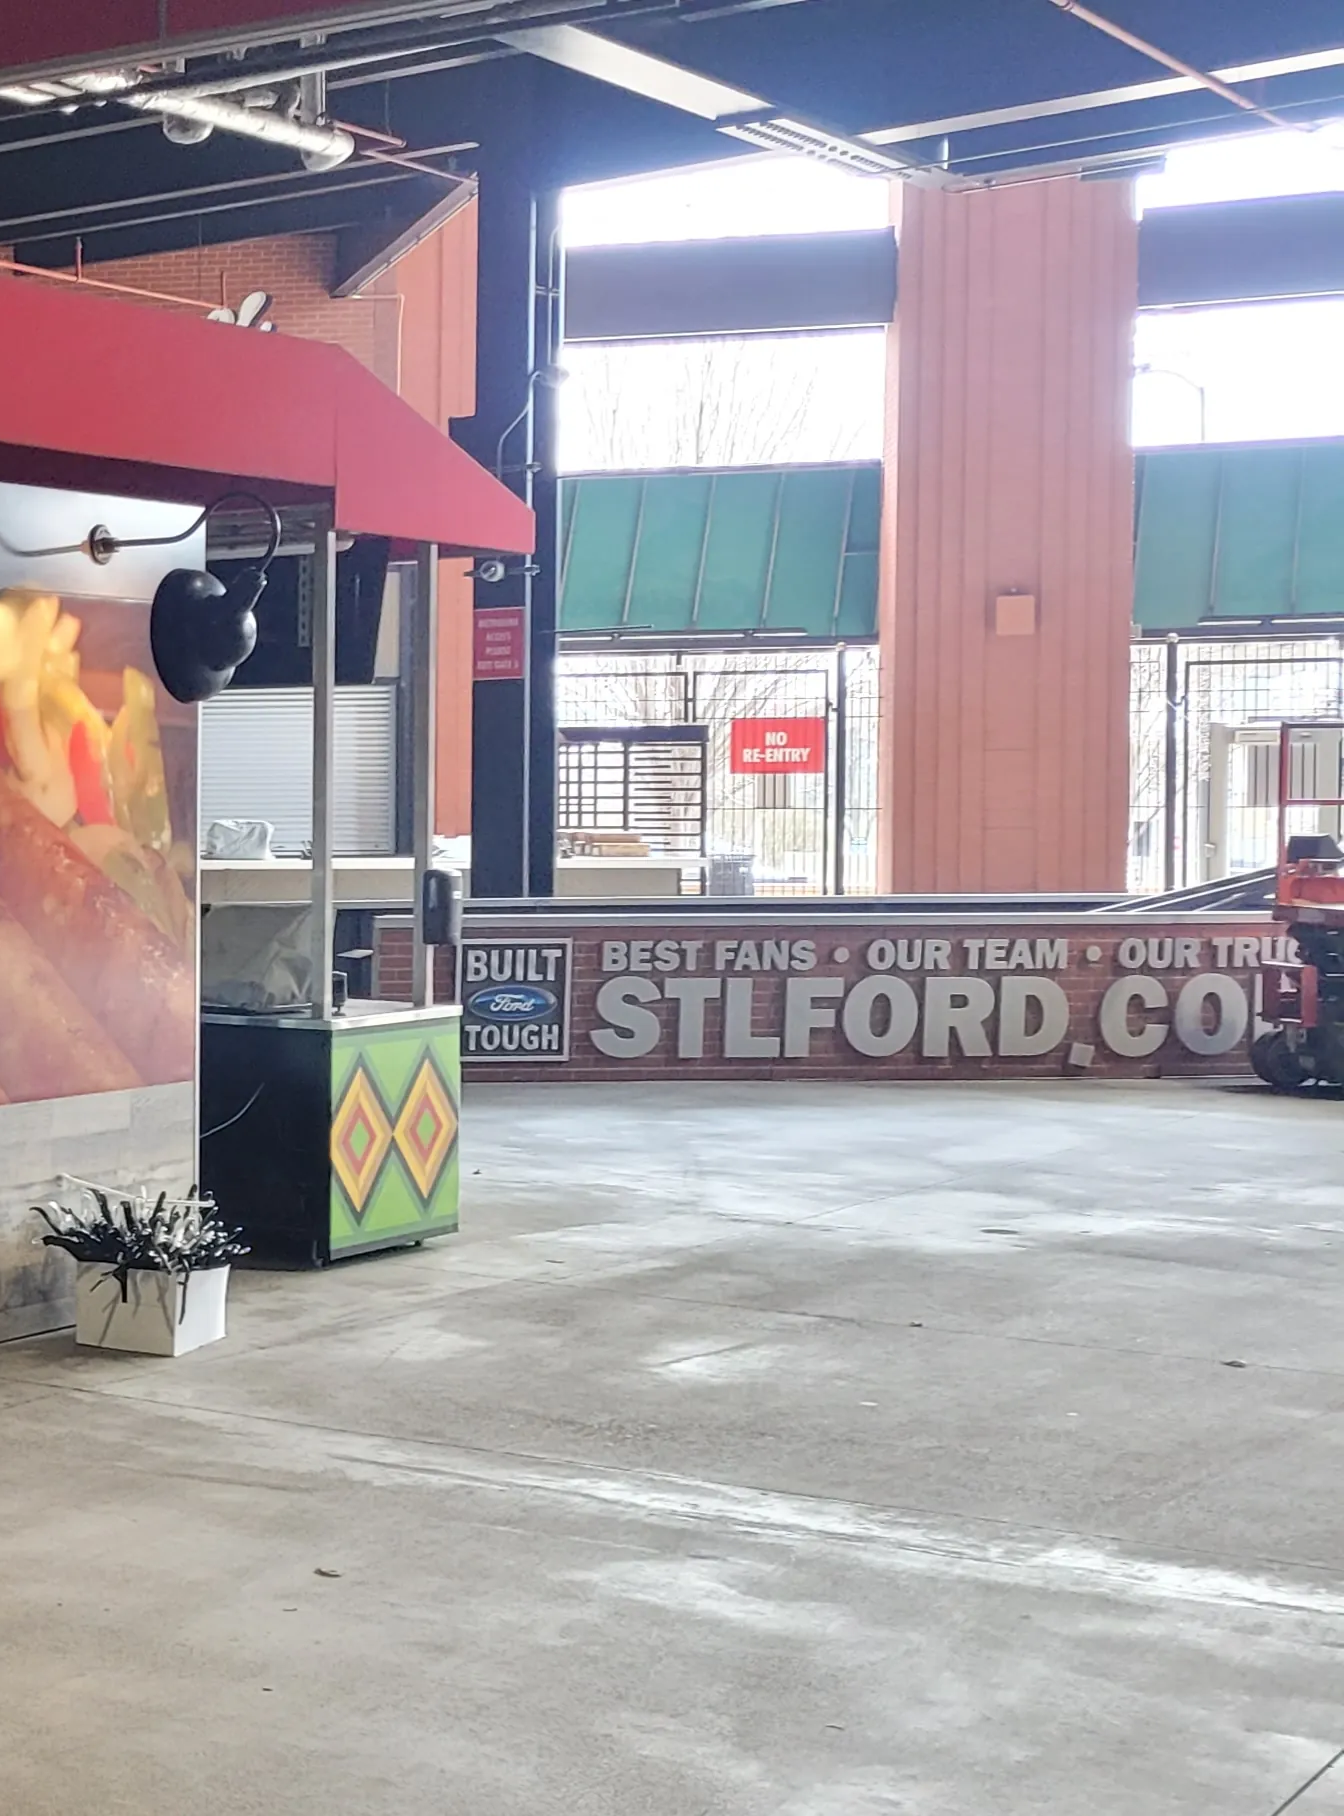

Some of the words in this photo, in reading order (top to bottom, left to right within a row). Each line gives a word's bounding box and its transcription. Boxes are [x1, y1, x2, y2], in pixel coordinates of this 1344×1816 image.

[765, 731, 788, 746] NO
[742, 748, 811, 763] RE-ENTRY
[466, 949, 562, 982] BUILT
[602, 940, 703, 971] BEST
[715, 940, 817, 971] FANS
[867, 939, 952, 970] OUR
[963, 938, 1068, 970] TEAM
[1118, 937, 1201, 969] OUR
[1212, 937, 1303, 967] TRUC
[490, 993, 535, 1012] Ford
[590, 974, 1284, 1067] STLFORD.CO
[464, 1024, 560, 1051] TOUGH
